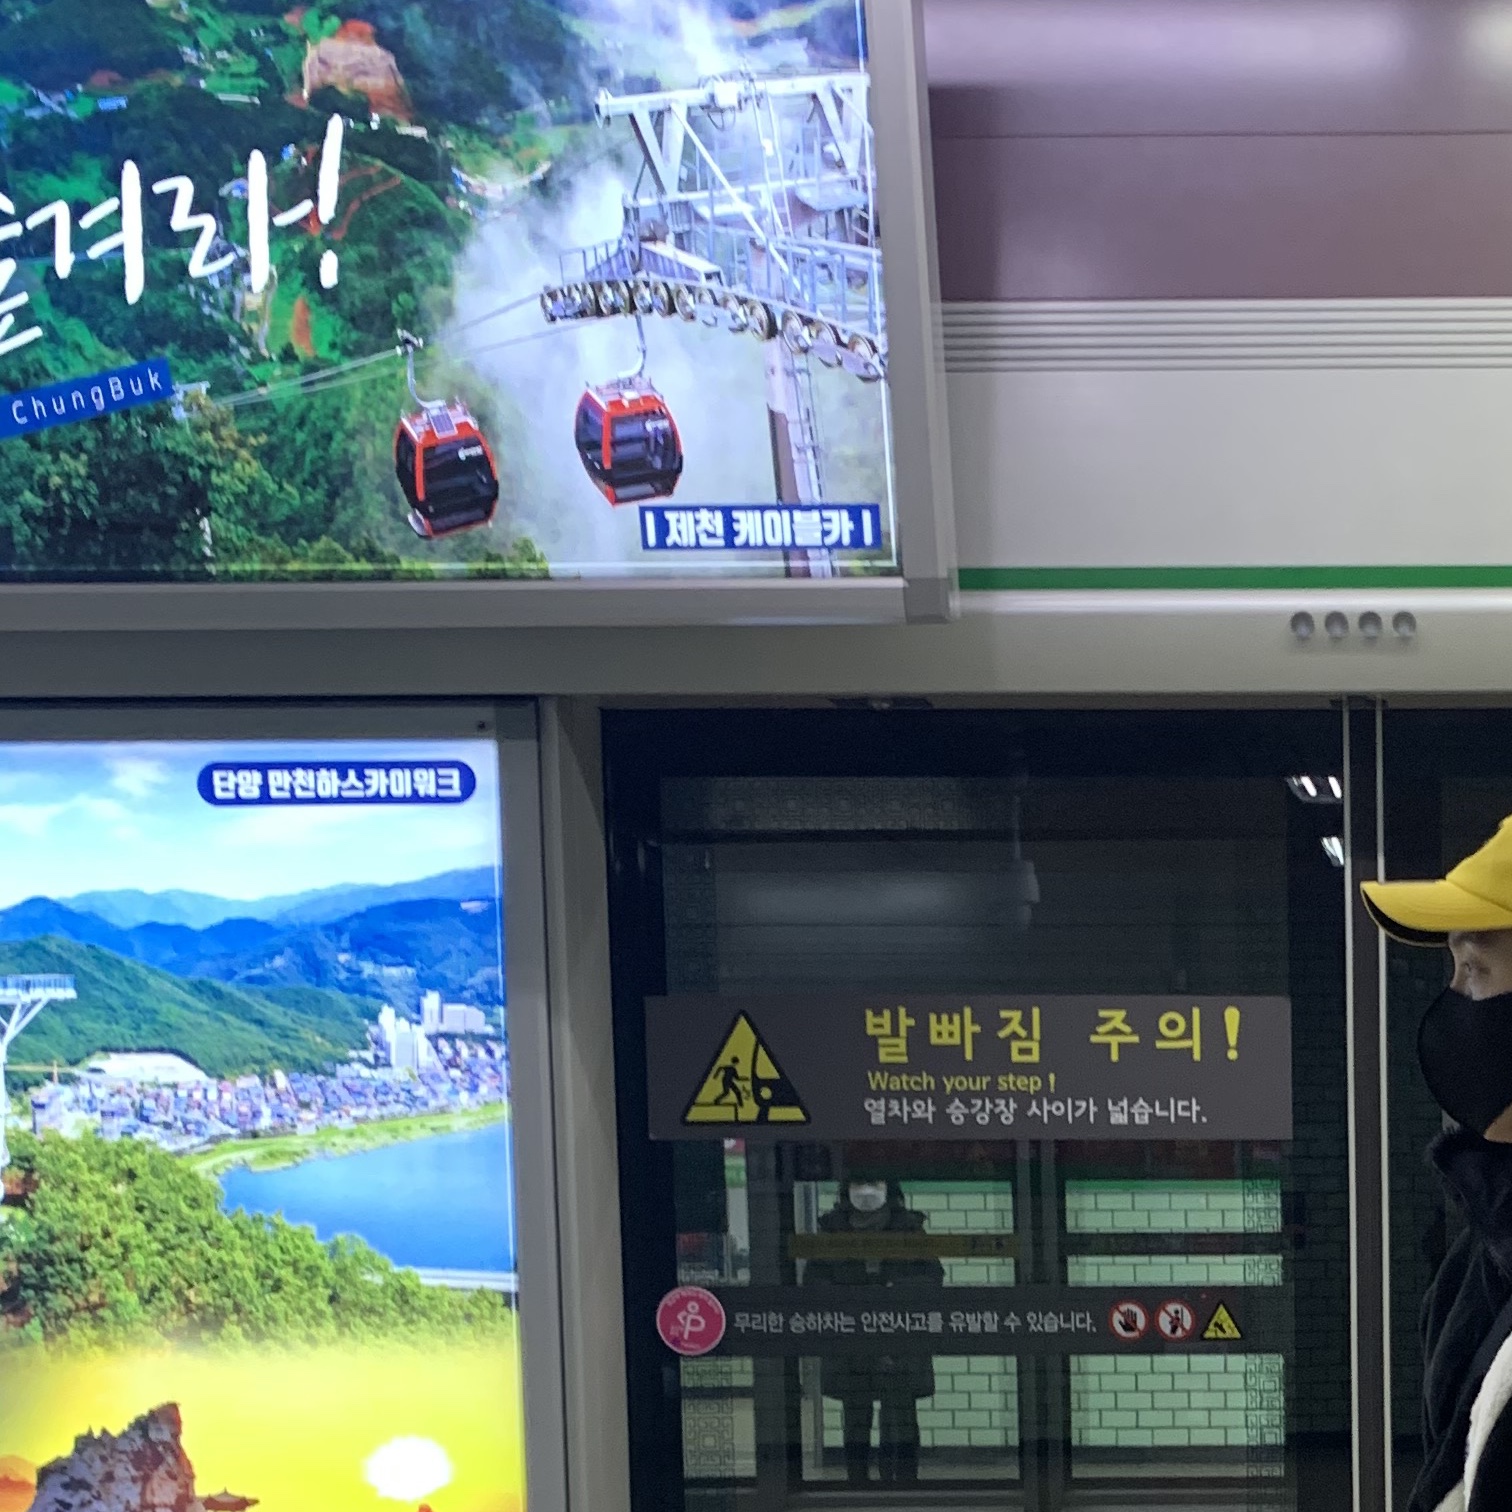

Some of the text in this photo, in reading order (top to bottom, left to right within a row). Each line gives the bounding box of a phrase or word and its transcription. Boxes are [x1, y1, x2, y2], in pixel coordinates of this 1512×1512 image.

[664, 507, 855, 548] 제천 케이블카
[212, 766, 463, 800] 단양 만천하스카이워크
[868, 1071, 936, 1092] Watch
[943, 1076, 991, 1095] your
[863, 1096, 1208, 1126] 열차와 승강장 사이가 넓습니다.
[733, 1310, 1098, 1334] 무리한 승하차는 안전사고를 유발할 수 있습니다.
